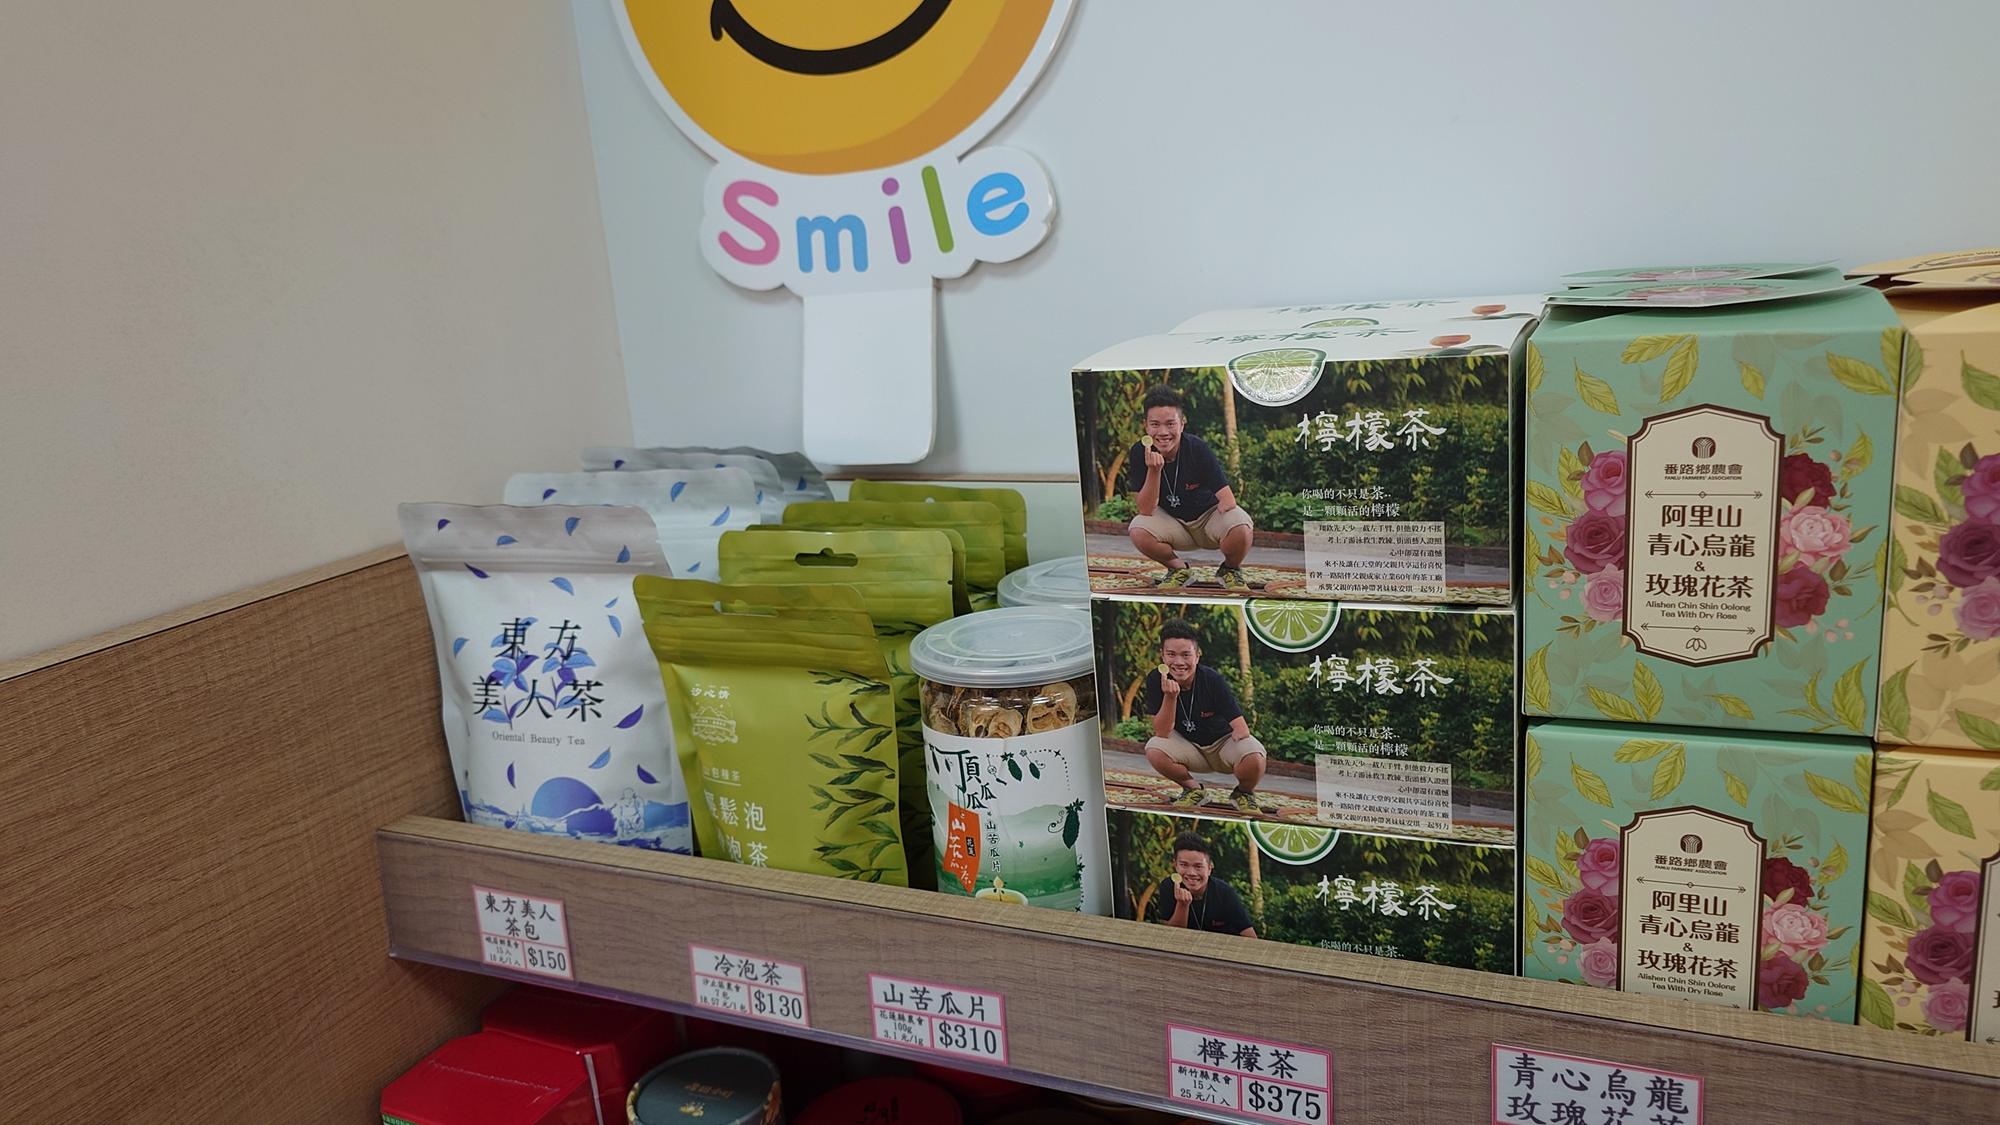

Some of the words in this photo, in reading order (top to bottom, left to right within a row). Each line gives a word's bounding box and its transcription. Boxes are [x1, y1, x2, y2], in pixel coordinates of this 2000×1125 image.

[718, 165, 1030, 273] Smile
[1295, 408, 1448, 452] 檸檬茶
[1664, 463, 1743, 475] 番路鄉農會
[1302, 503, 1400, 518] 是一顆顆活的檸檬
[1661, 504, 1742, 529] 阿里山
[1646, 533, 1756, 558] 青心烏龍
[1694, 561, 1705, 572] &
[1645, 574, 1754, 600] 玫瑰花茶
[1700, 602, 1718, 610] Shin
[1721, 603, 1751, 612] Oolong
[1716, 612, 1737, 620] Rose
[495, 617, 582, 660] 東方
[1307, 654, 1454, 698] 檸檬茶
[472, 675, 605, 722] 美人茶
[492, 731, 525, 743] Oriental
[531, 734, 562, 746] Beauty
[567, 735, 585, 745] Tea
[986, 820, 1001, 872] 山苦瓜片
[1654, 855, 1728, 871] 番路鄉農會
[485, 892, 556, 922] 東方美人
[1315, 874, 1457, 921] 檸檬茶
[1652, 890, 1728, 917] 阿里山
[505, 917, 540, 940] 茶包
[1639, 914, 1740, 944] 青心烏龍
[527, 945, 567, 971] $150
[1683, 942, 1693, 952] &
[714, 954, 782, 987] 冷泡茶
[1637, 949, 1738, 980] 玫瑰花茶
[1652, 982, 1666, 990] Tea
[1668, 984, 1685, 992] With
[1688, 986, 1702, 995] Dry
[1704, 989, 1723, 997] Rose
[1668, 976, 1686, 985] Chin
[1688, 978, 1706, 987] Shin
[1708, 981, 1736, 991] Oolong
[754, 989, 803, 1020] $130
[883, 983, 985, 1022] 山苦瓜片
[893, 1022, 912, 1034] 100g
[939, 1020, 997, 1055] $310
[1196, 1037, 1298, 1080] 檸檬茶
[1178, 1066, 1233, 1085] 新竹縣農會
[1193, 1079, 1204, 1090] 15
[1207, 1084, 1218, 1093] 入
[1509, 1053, 1689, 1115] 青心烏龍
[1180, 1089, 1192, 1099] 25
[1195, 1092, 1215, 1103] 元/1
[1220, 1098, 1231, 1107] 入
[1248, 1081, 1321, 1121] $375
[1505, 1093, 1684, 1125] 玫瑰花
